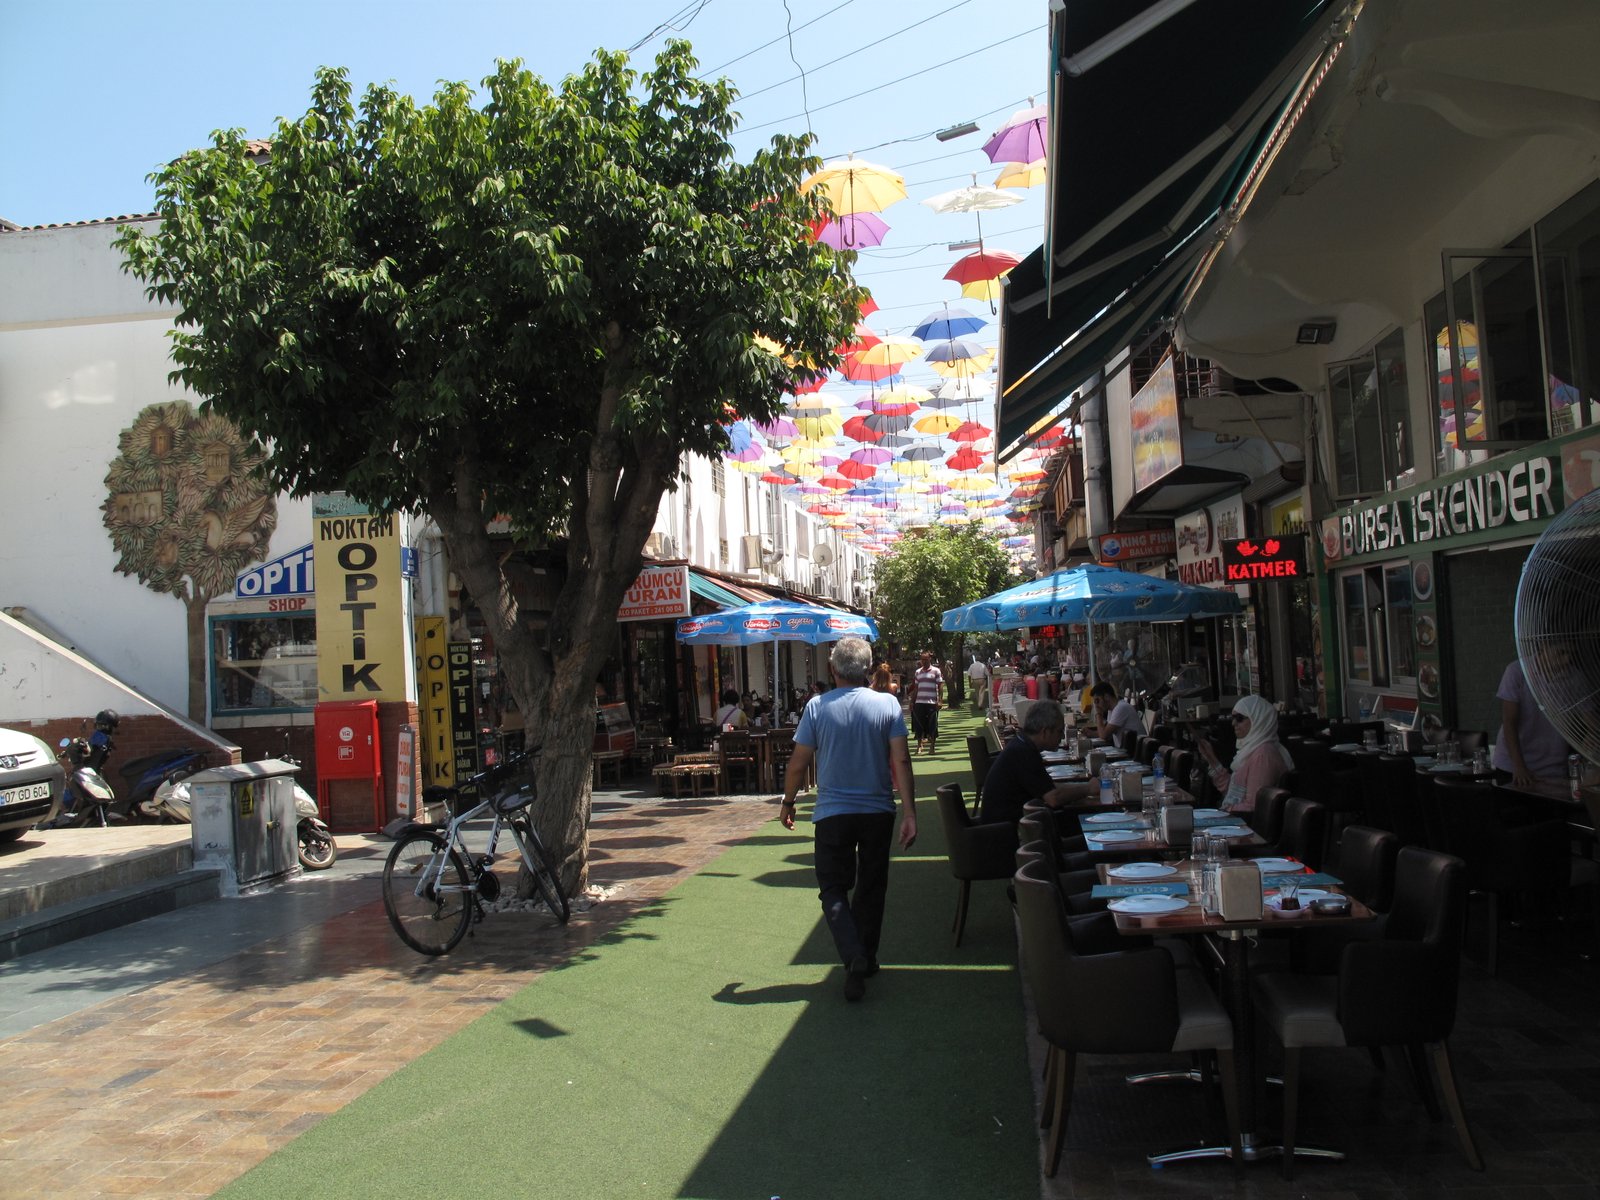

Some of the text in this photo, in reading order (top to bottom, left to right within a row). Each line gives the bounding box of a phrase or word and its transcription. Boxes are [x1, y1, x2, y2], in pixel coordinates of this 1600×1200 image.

[320, 516, 393, 540] NOKTAM
[1342, 501, 1404, 556] BURSA
[1120, 535, 1146, 548] KING
[1149, 531, 1175, 544] FISH
[1228, 560, 1297, 579] KATMER
[624, 587, 681, 603] URAN
[269, 598, 306, 612] SHOP
[630, 608, 650, 616] PAKET
[5, 786, 47, 803] 07 GD 604
